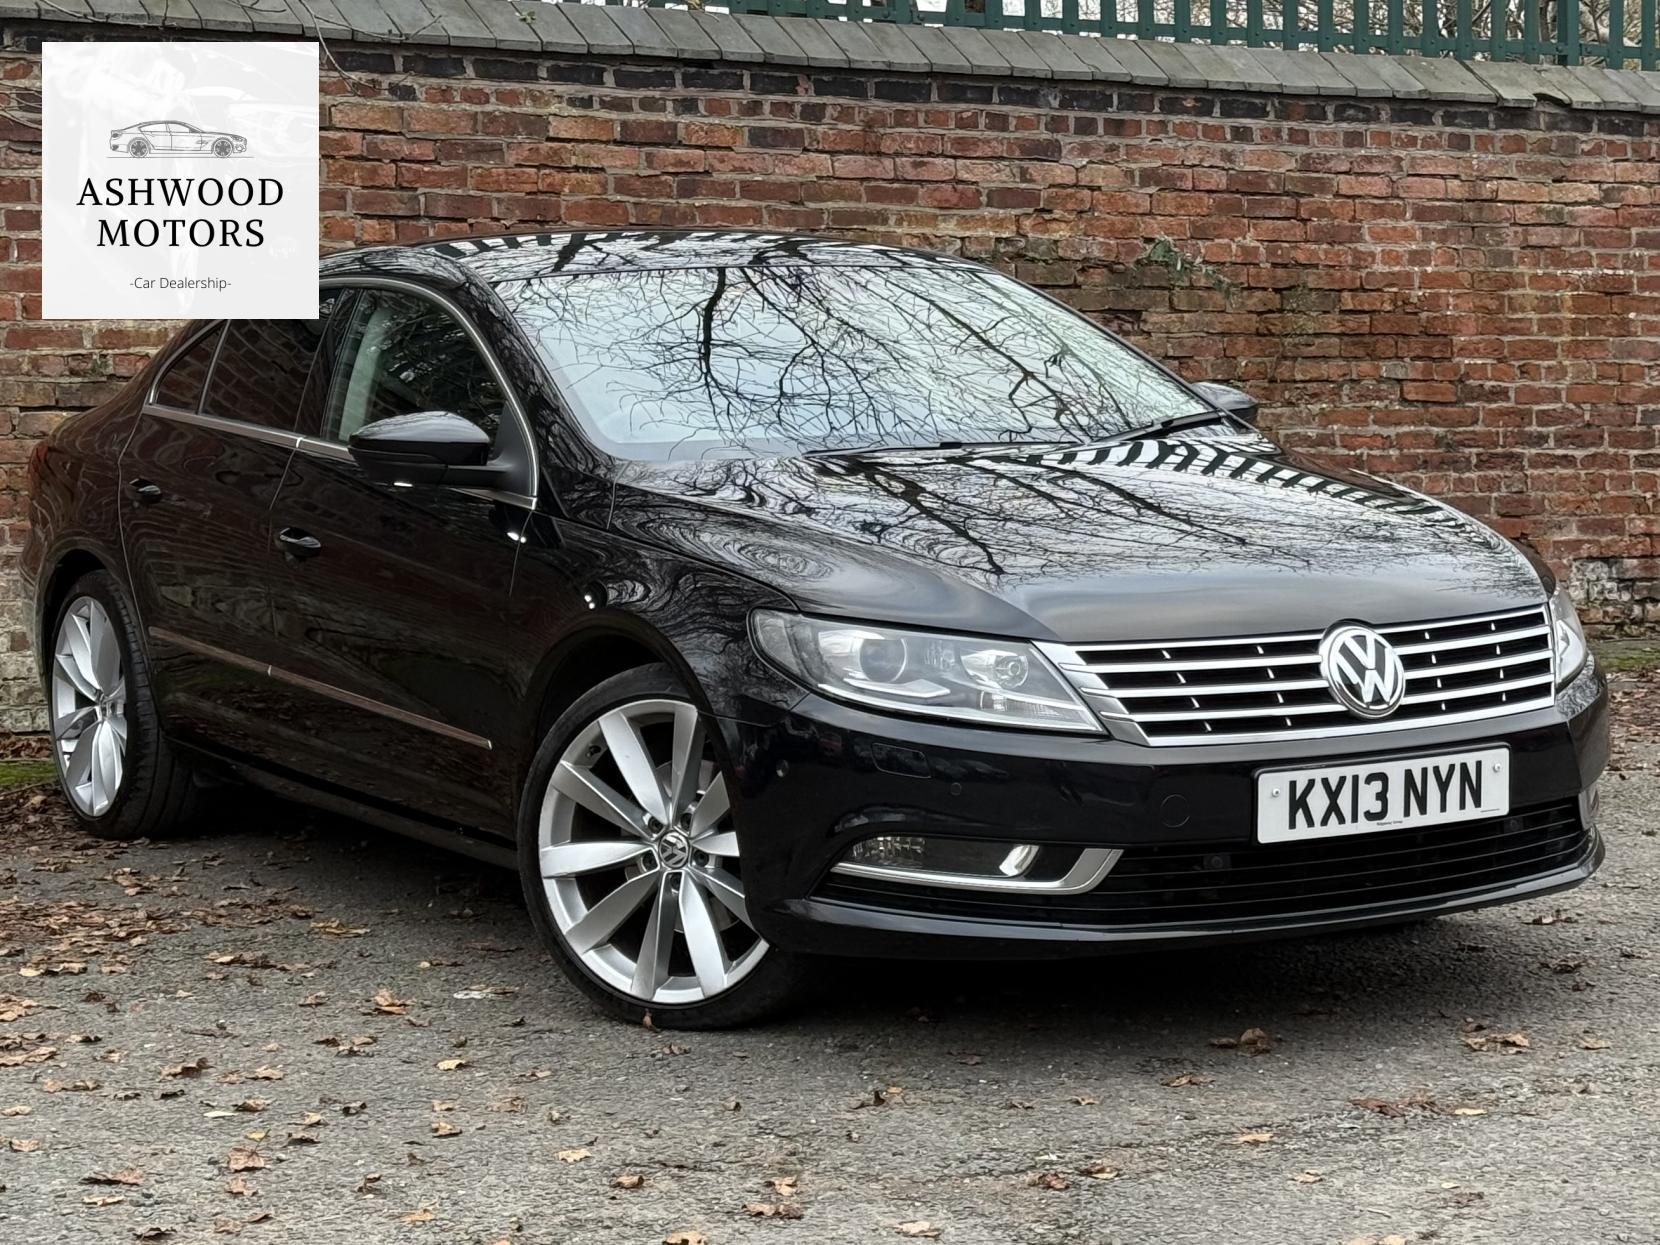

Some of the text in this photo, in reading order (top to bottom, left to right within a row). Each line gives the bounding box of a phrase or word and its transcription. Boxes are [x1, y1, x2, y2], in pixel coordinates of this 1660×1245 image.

[1329, 629, 1401, 709] VW
[1288, 760, 1482, 830] KX13 NYN
